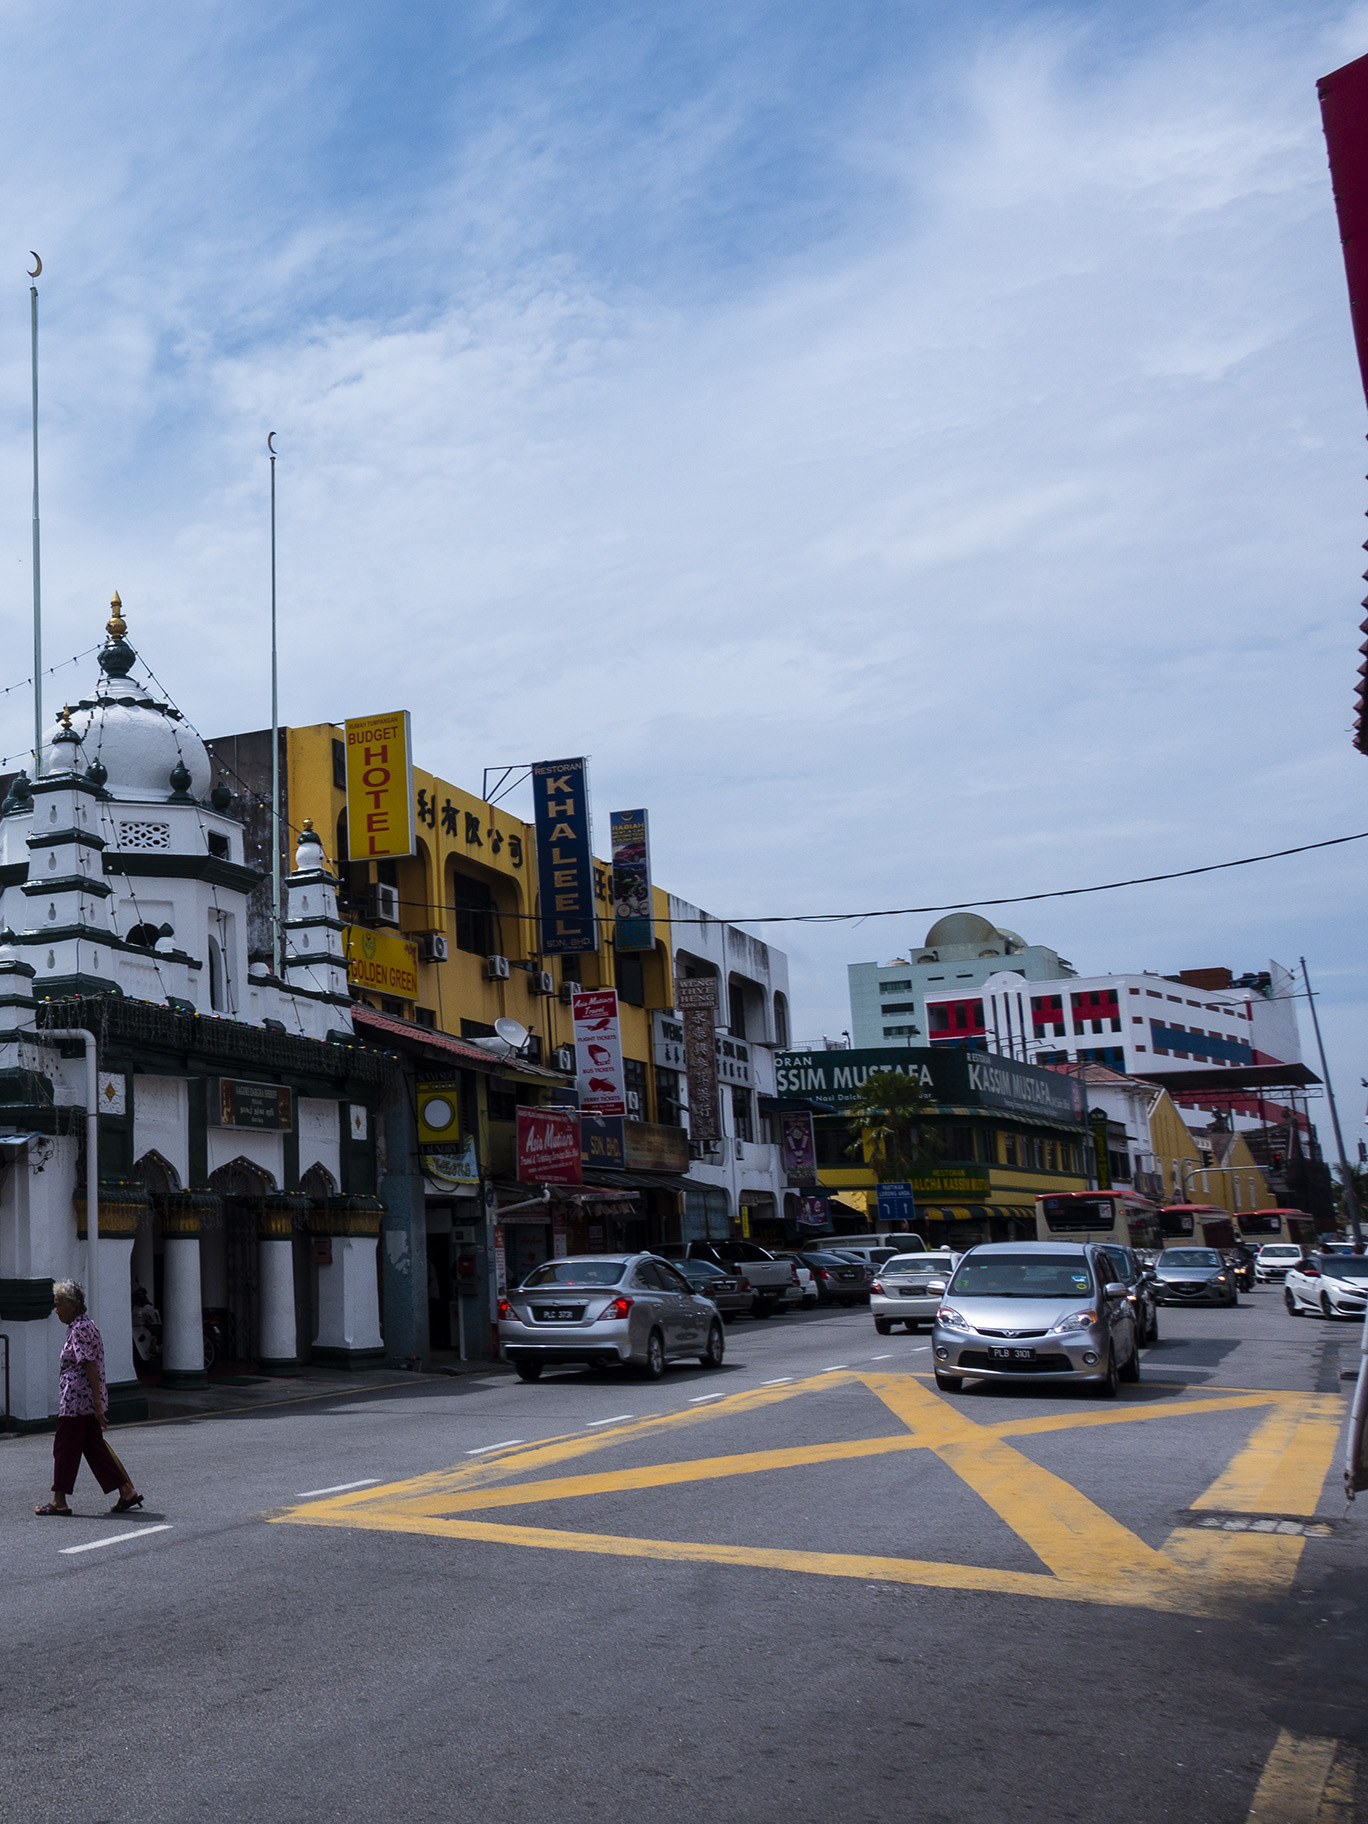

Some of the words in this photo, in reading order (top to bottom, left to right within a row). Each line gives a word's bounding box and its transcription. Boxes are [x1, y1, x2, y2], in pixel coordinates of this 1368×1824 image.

[348, 726, 398, 745] BUDGET
[534, 762, 582, 775] RESTORAN
[362, 744, 391, 855] HOTEL
[612, 822, 644, 832] RABIAH
[545, 774, 582, 935] KHALEEL
[351, 957, 388, 986] GOLDEN
[389, 967, 418, 993] GREEN
[679, 979, 714, 987] WENG
[679, 987, 714, 995] THYE
[680, 994, 715, 1002] HENG
[661, 1020, 683, 1044] WENG
[774, 1056, 812, 1067] ORAN
[776, 1067, 828, 1092] SSIM
[967, 1063, 1012, 1097] KASSIM
[1012, 1073, 1051, 1107] MUSTAFA
[525, 1125, 543, 1153] Asia
[543, 1122, 574, 1150] Mutiara
[420, 1144, 457, 1155] LAUNDRY
[543, 1311, 556, 1319] PLC
[993, 1348, 1010, 1358] PLB
[1014, 1349, 1031, 1359] 3101
